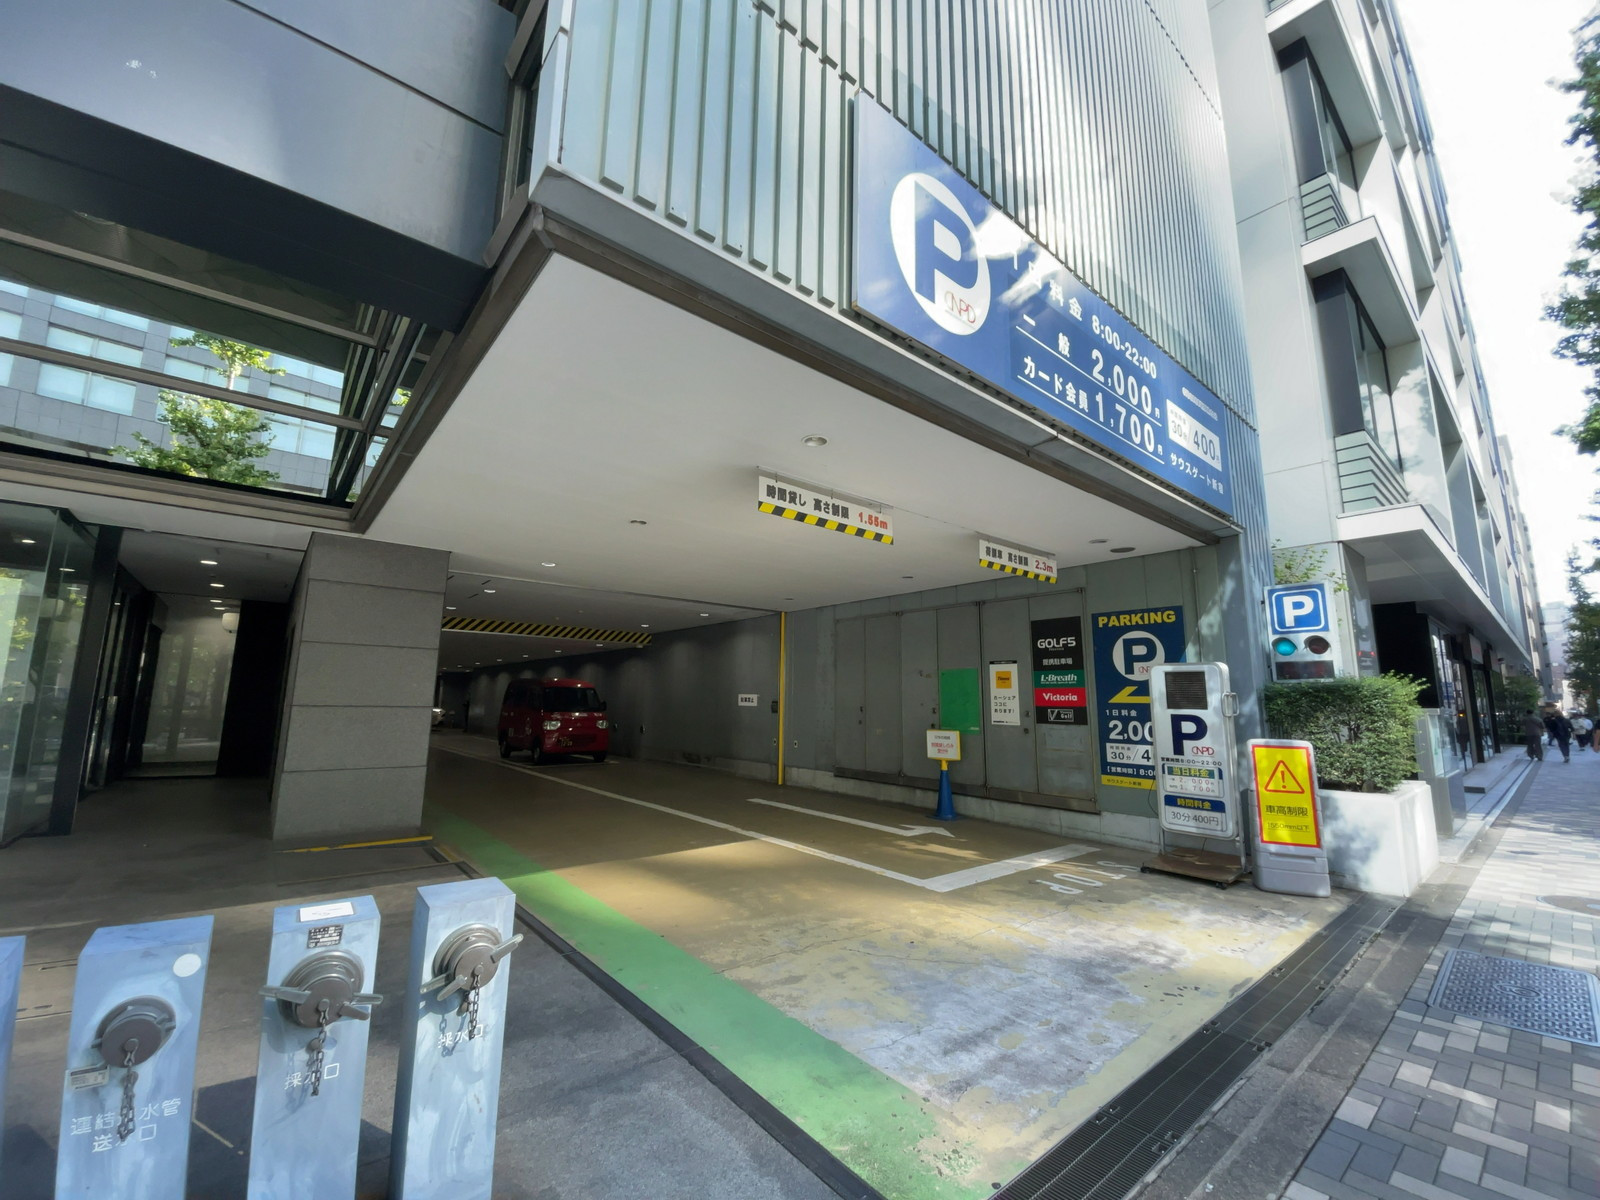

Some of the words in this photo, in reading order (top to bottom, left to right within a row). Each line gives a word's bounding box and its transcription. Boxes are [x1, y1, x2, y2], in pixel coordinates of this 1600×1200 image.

[1091, 314, 1157, 379] 8:00-22:00
[1023, 355, 1089, 413] カード会員
[766, 484, 807, 507] 時間貸し
[813, 497, 850, 520] 高さ制限
[858, 511, 888, 530] 1.55m
[1034, 559, 1054, 574] 2.3m
[1097, 610, 1177, 628] PARKING
[1282, 595, 1314, 627] P
[1037, 636, 1077, 649] GOLF5
[1122, 637, 1158, 676] P
[1042, 692, 1078, 702] Victoria
[1105, 709, 1138, 717] 1日料金
[1170, 714, 1208, 756] P
[1265, 804, 1309, 817] 車高制限
